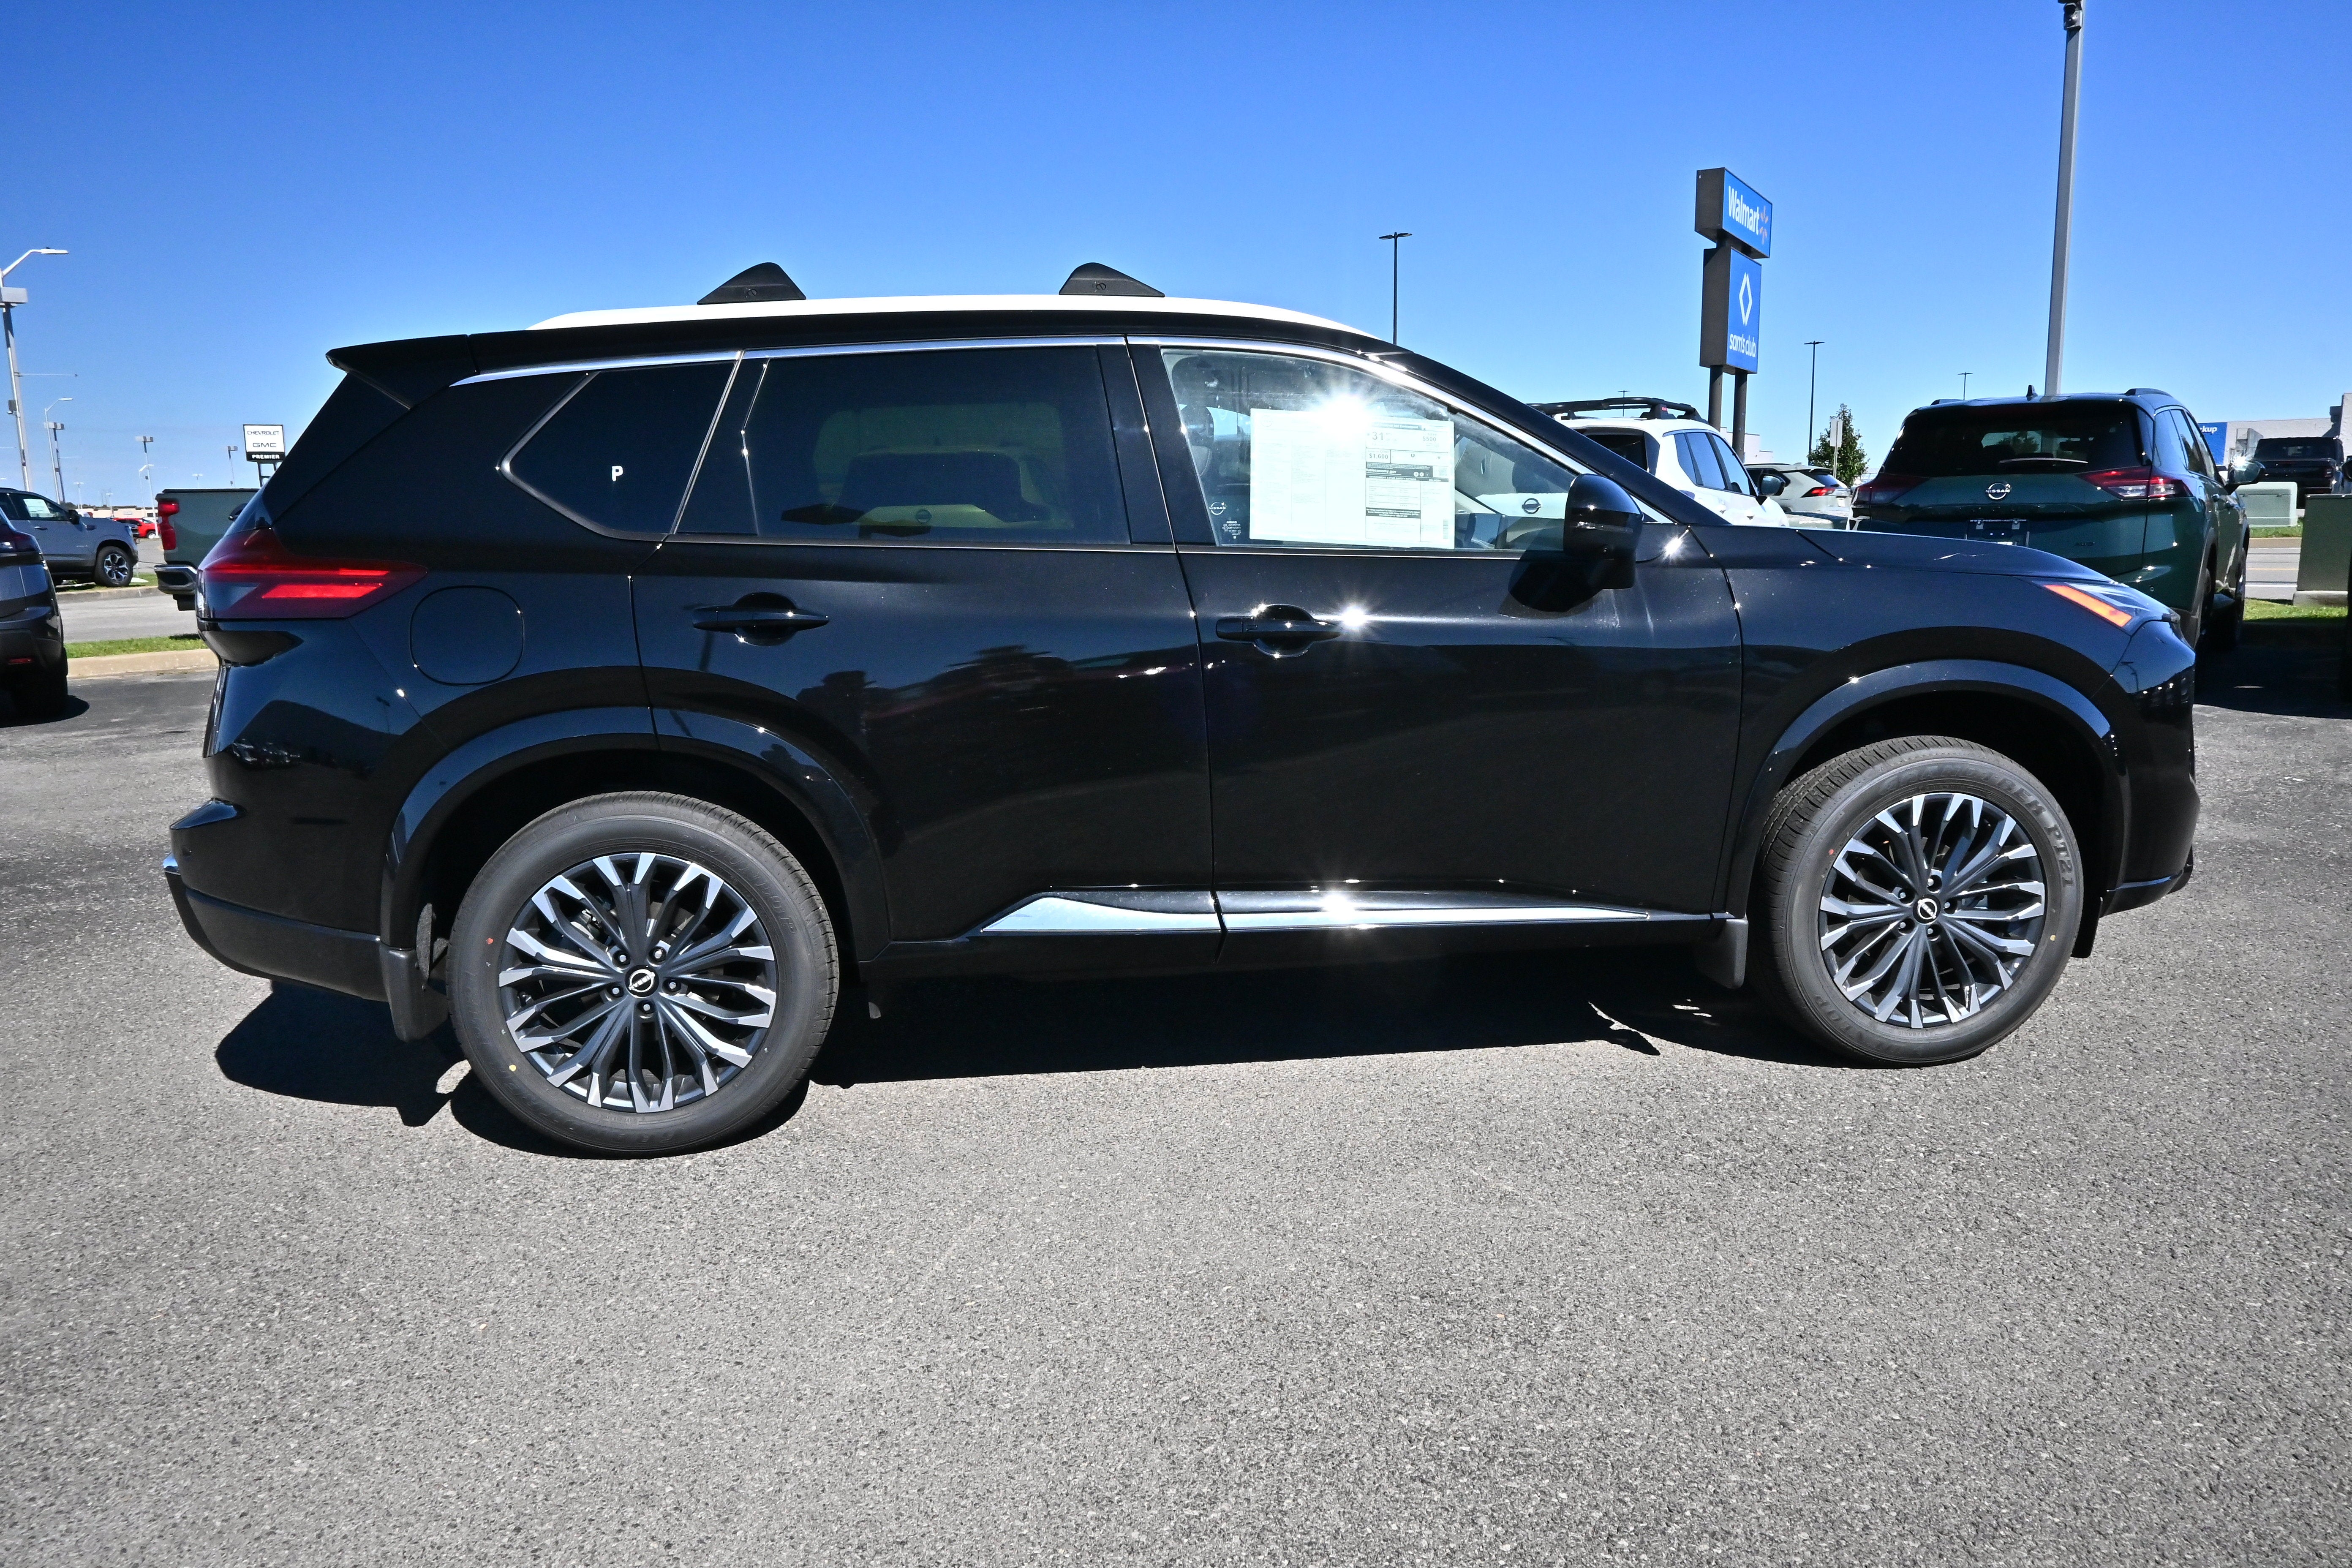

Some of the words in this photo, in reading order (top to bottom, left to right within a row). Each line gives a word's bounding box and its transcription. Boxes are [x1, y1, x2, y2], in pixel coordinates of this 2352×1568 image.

[1728, 185, 1760, 235] Walmart
[1729, 333, 1745, 354] sam's
[1745, 335, 1756, 358] club
[1372, 431, 1383, 441] 31
[612, 466, 623, 482] P
[2044, 823, 2074, 888] PT21
